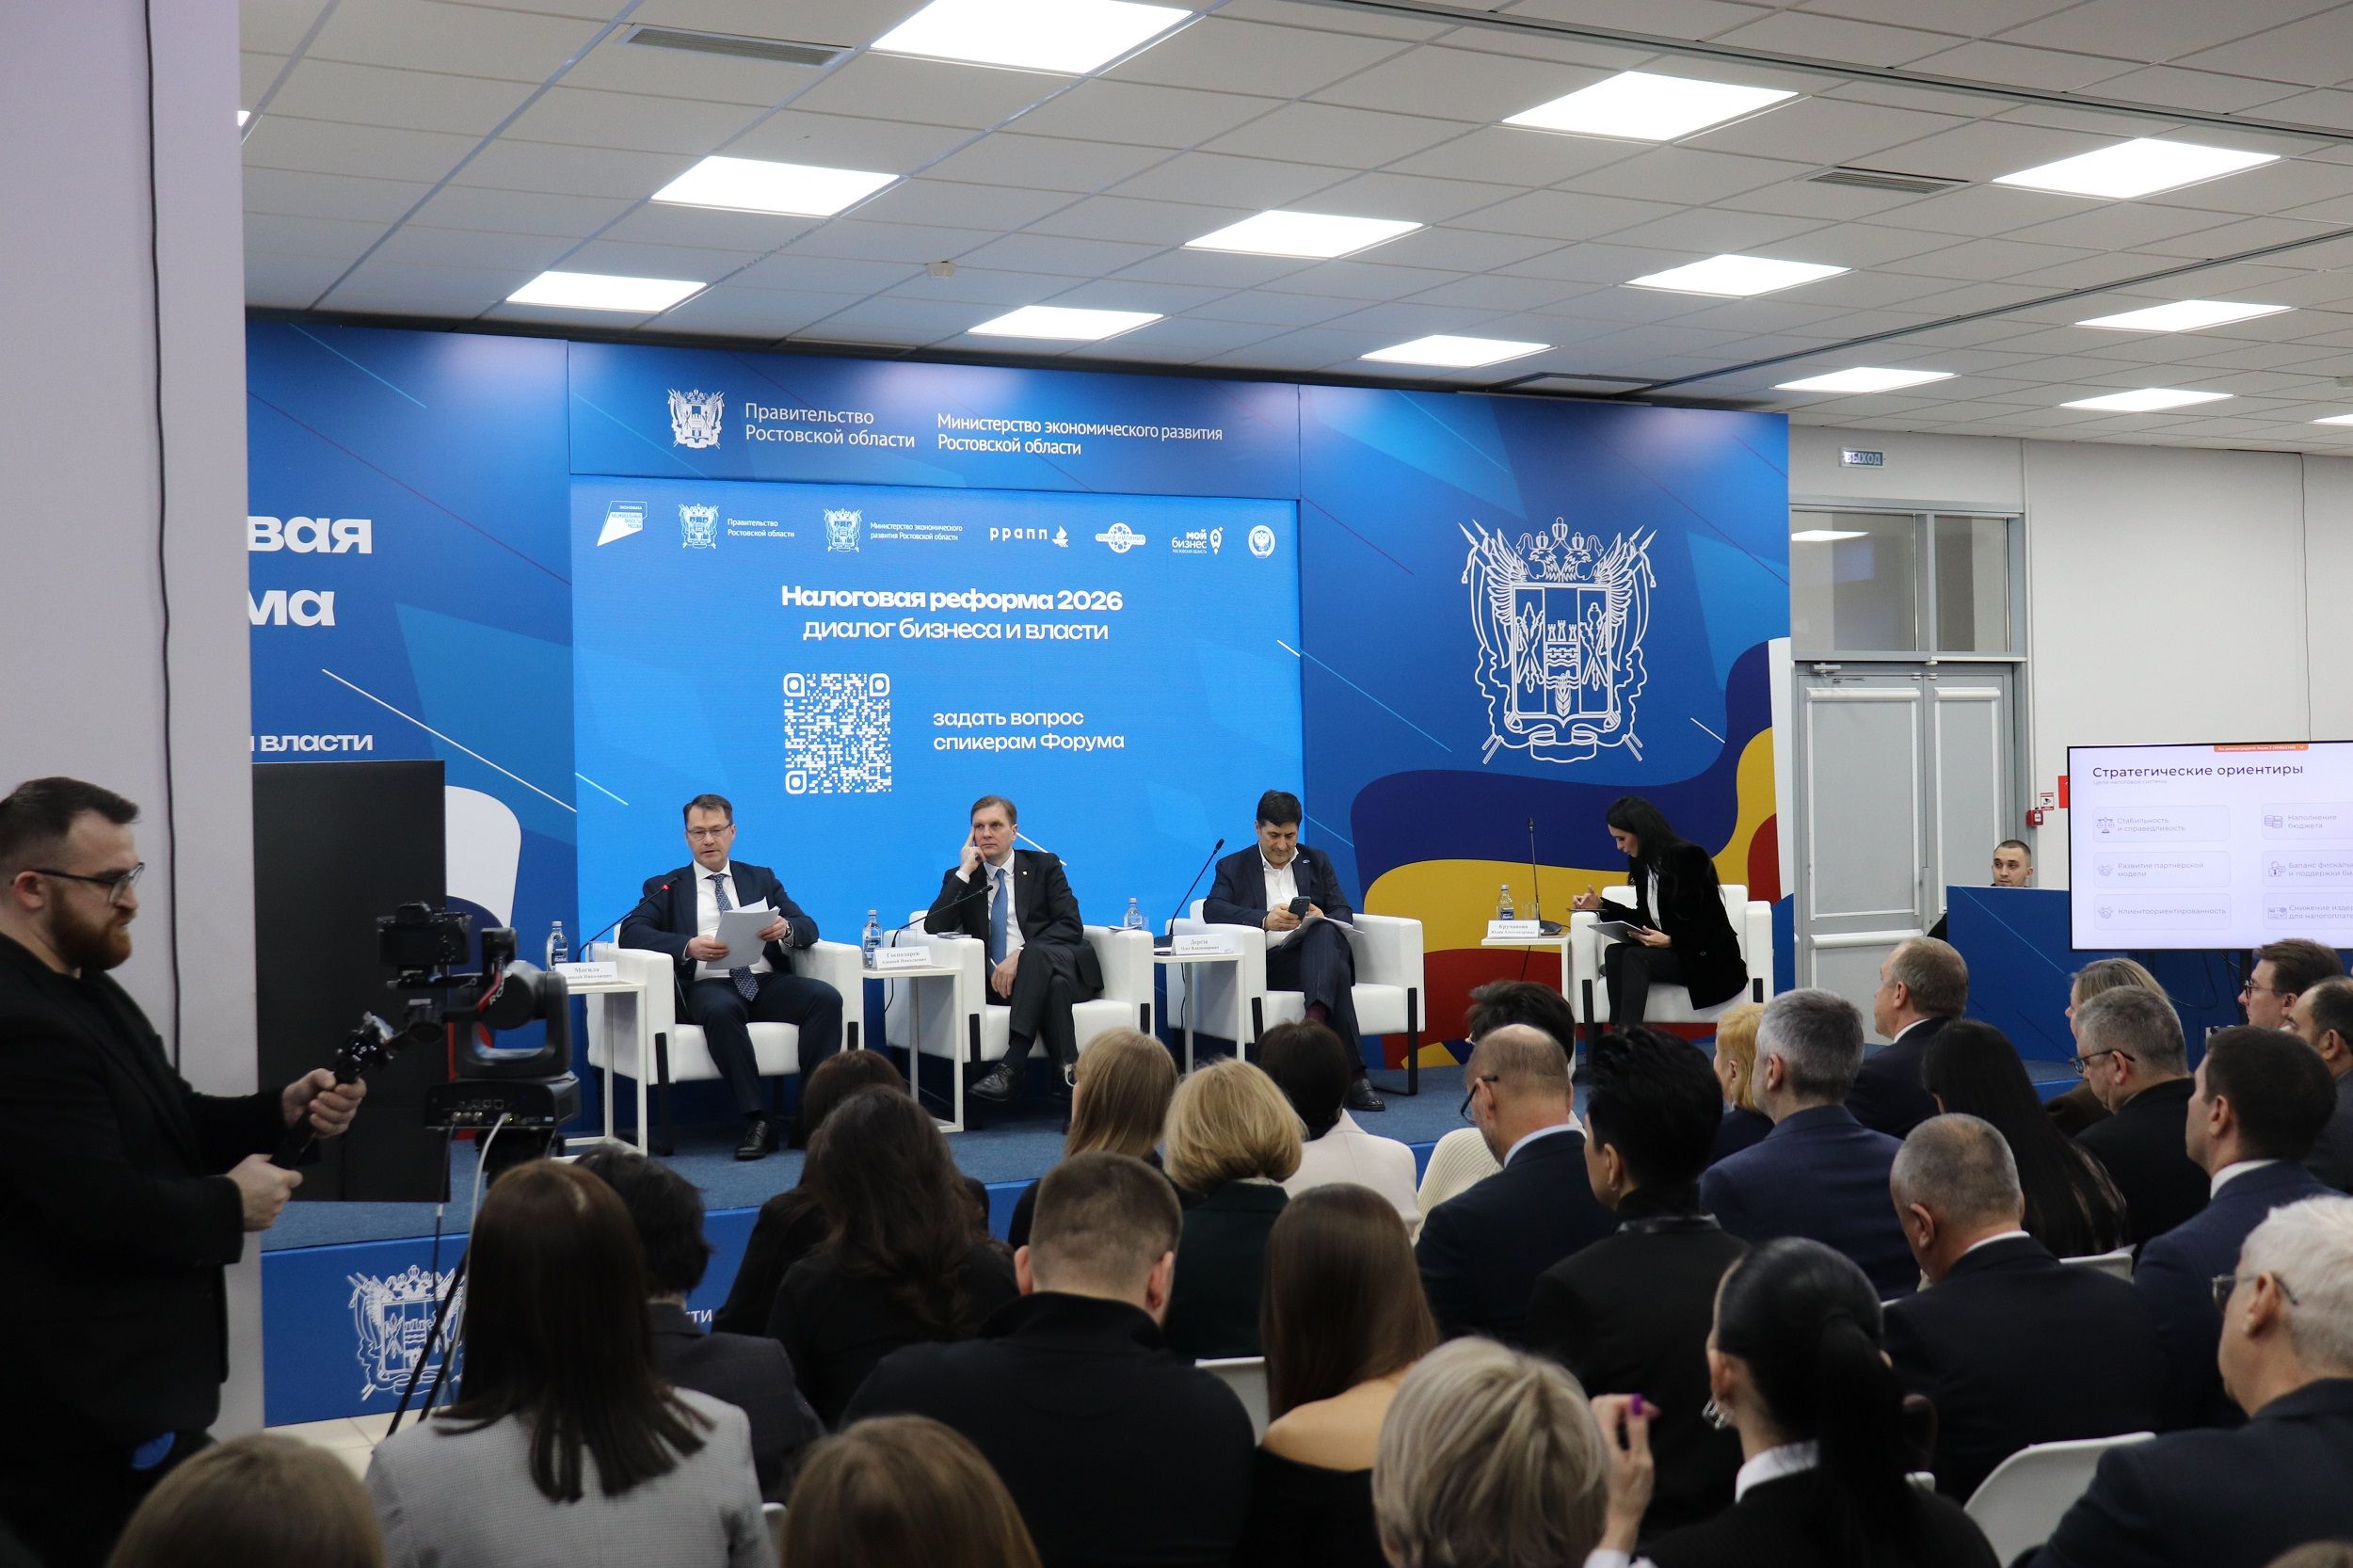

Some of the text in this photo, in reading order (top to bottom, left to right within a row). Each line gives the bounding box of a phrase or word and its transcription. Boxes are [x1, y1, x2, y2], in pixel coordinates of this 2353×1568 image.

[745, 403, 873, 424] Правительство
[937, 413, 1223, 441] Министерство экономического развития
[746, 424, 916, 448] Ростовской области
[938, 433, 1081, 455] Ростовской области
[1846, 452, 1881, 465] ВЫХОД
[727, 518, 779, 528] Правительство
[870, 521, 964, 533] Министерство экономического
[728, 529, 767, 537] Ростовской
[870, 532, 959, 541] развития Ростовской области
[1186, 528, 1208, 540] мой
[1171, 536, 1208, 549] бизнес
[781, 585, 1124, 613] Налоговая реформа 2026
[803, 617, 1109, 641] диалог бизнеса и власти
[933, 712, 1084, 729] задать вопрос
[260, 734, 374, 752] власти
[933, 733, 1125, 752] спикерам Форума
[2092, 764, 2304, 779] Стратегические ориентиры
[2295, 869, 2341, 877] поддержки
[2289, 904, 2330, 912] Снижение
